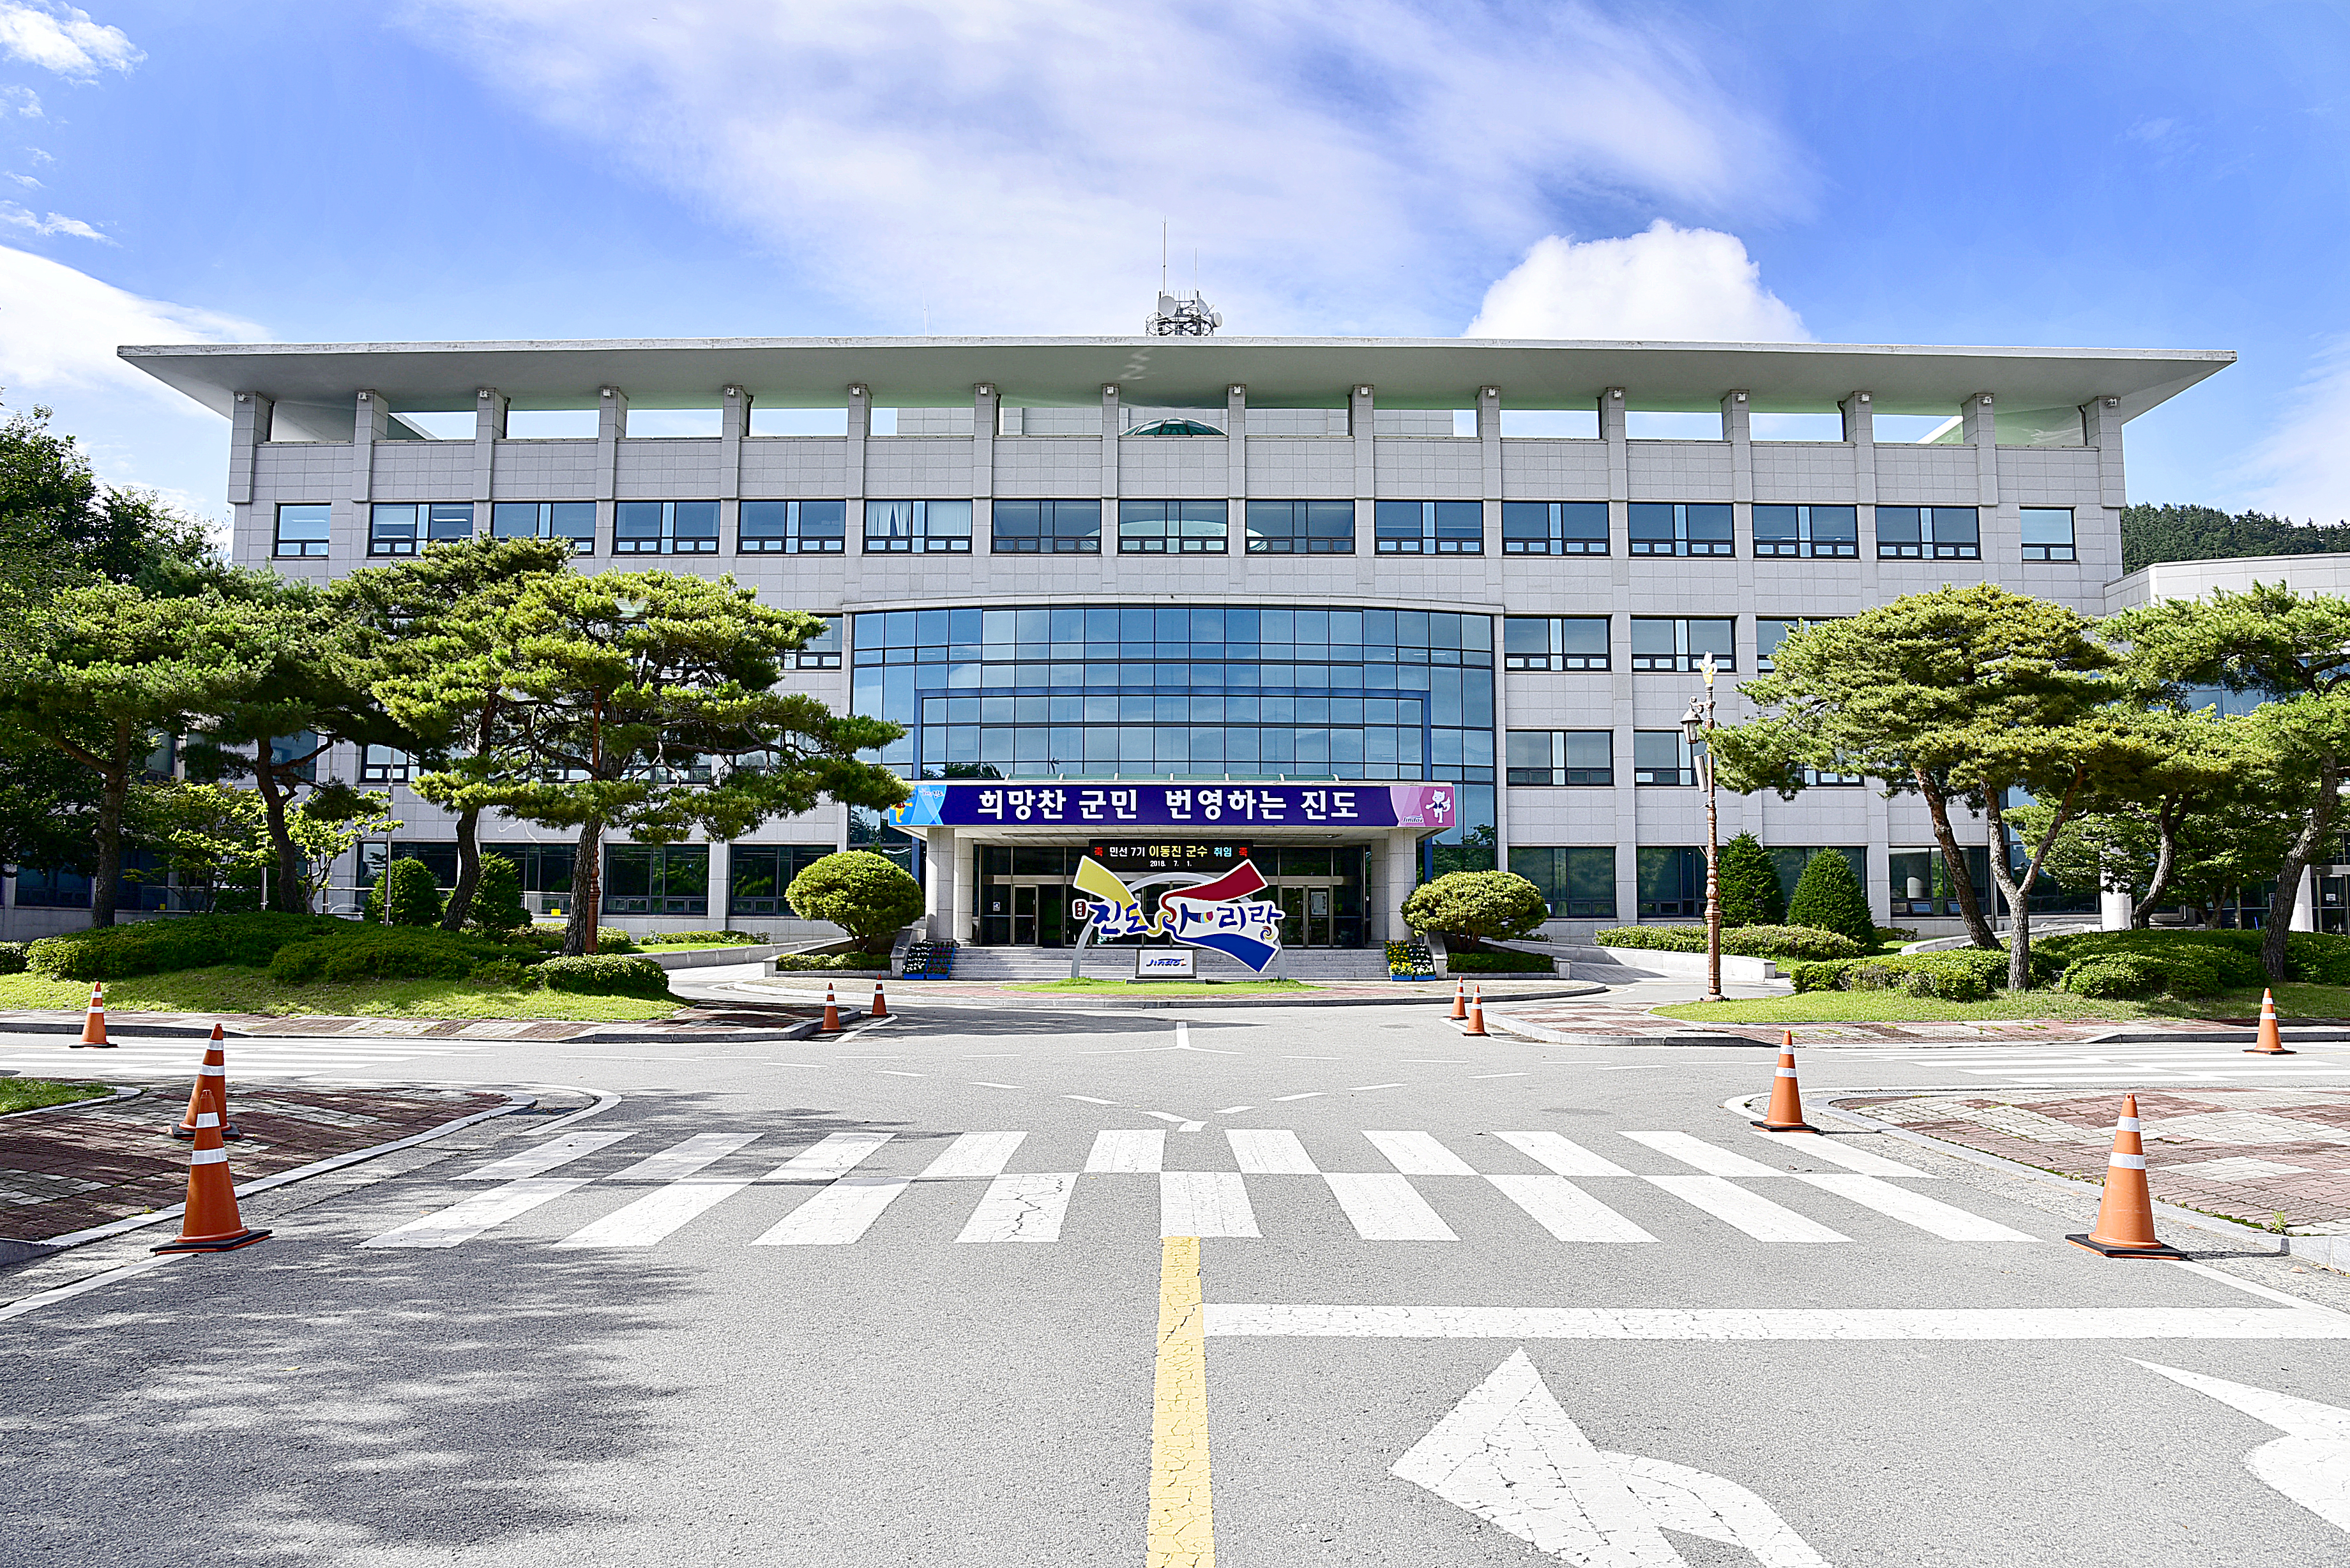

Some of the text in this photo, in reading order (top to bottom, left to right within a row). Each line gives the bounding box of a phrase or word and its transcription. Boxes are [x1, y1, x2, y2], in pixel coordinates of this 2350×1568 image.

[978, 789, 1358, 820] 희망찬 군민 번영하는 진도
[1094, 845, 1248, 857] 축 민선 7기 이동진 군수 취임 축
[1089, 901, 1149, 935] 진도
